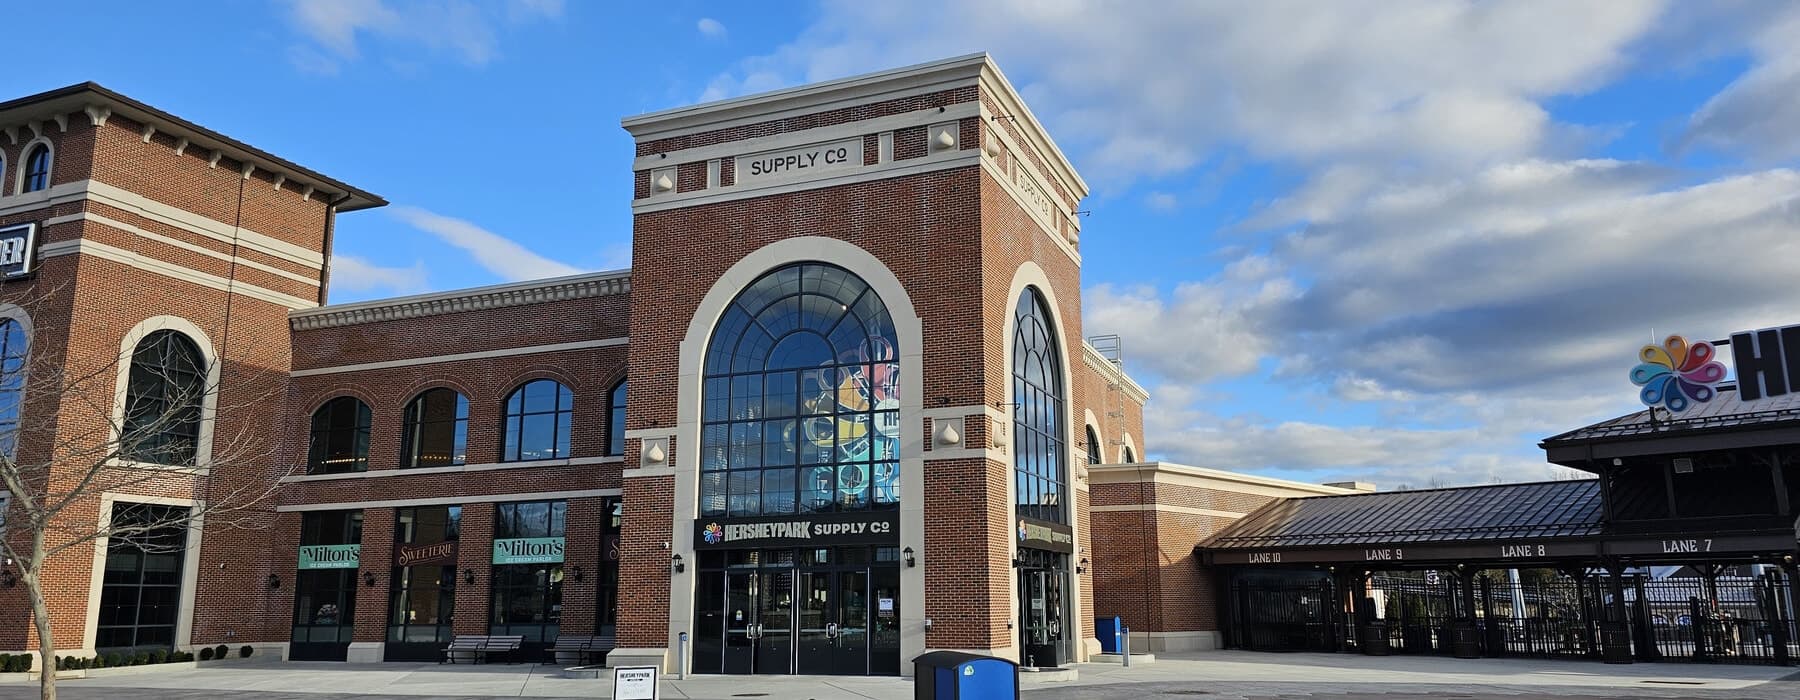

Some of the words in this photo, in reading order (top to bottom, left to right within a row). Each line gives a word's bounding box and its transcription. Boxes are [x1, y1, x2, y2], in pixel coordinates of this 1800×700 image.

[752, 151, 820, 176] SUPPLY
[1020, 174, 1041, 207] SUPPLY
[0, 236, 25, 265] ER
[724, 521, 812, 542] HERSHEYPARK
[814, 522, 868, 536] SUPPLY
[303, 546, 360, 562] Milton's
[498, 539, 563, 557] Milton's
[1502, 545, 1532, 557] LANE
[1537, 544, 1545, 556] 8
[1662, 540, 1698, 553] LANE
[1704, 539, 1713, 552] 7
[1249, 552, 1271, 563] LANE
[1273, 552, 1281, 563] 10
[1366, 549, 1391, 561] LANE
[1396, 549, 1403, 560] 9
